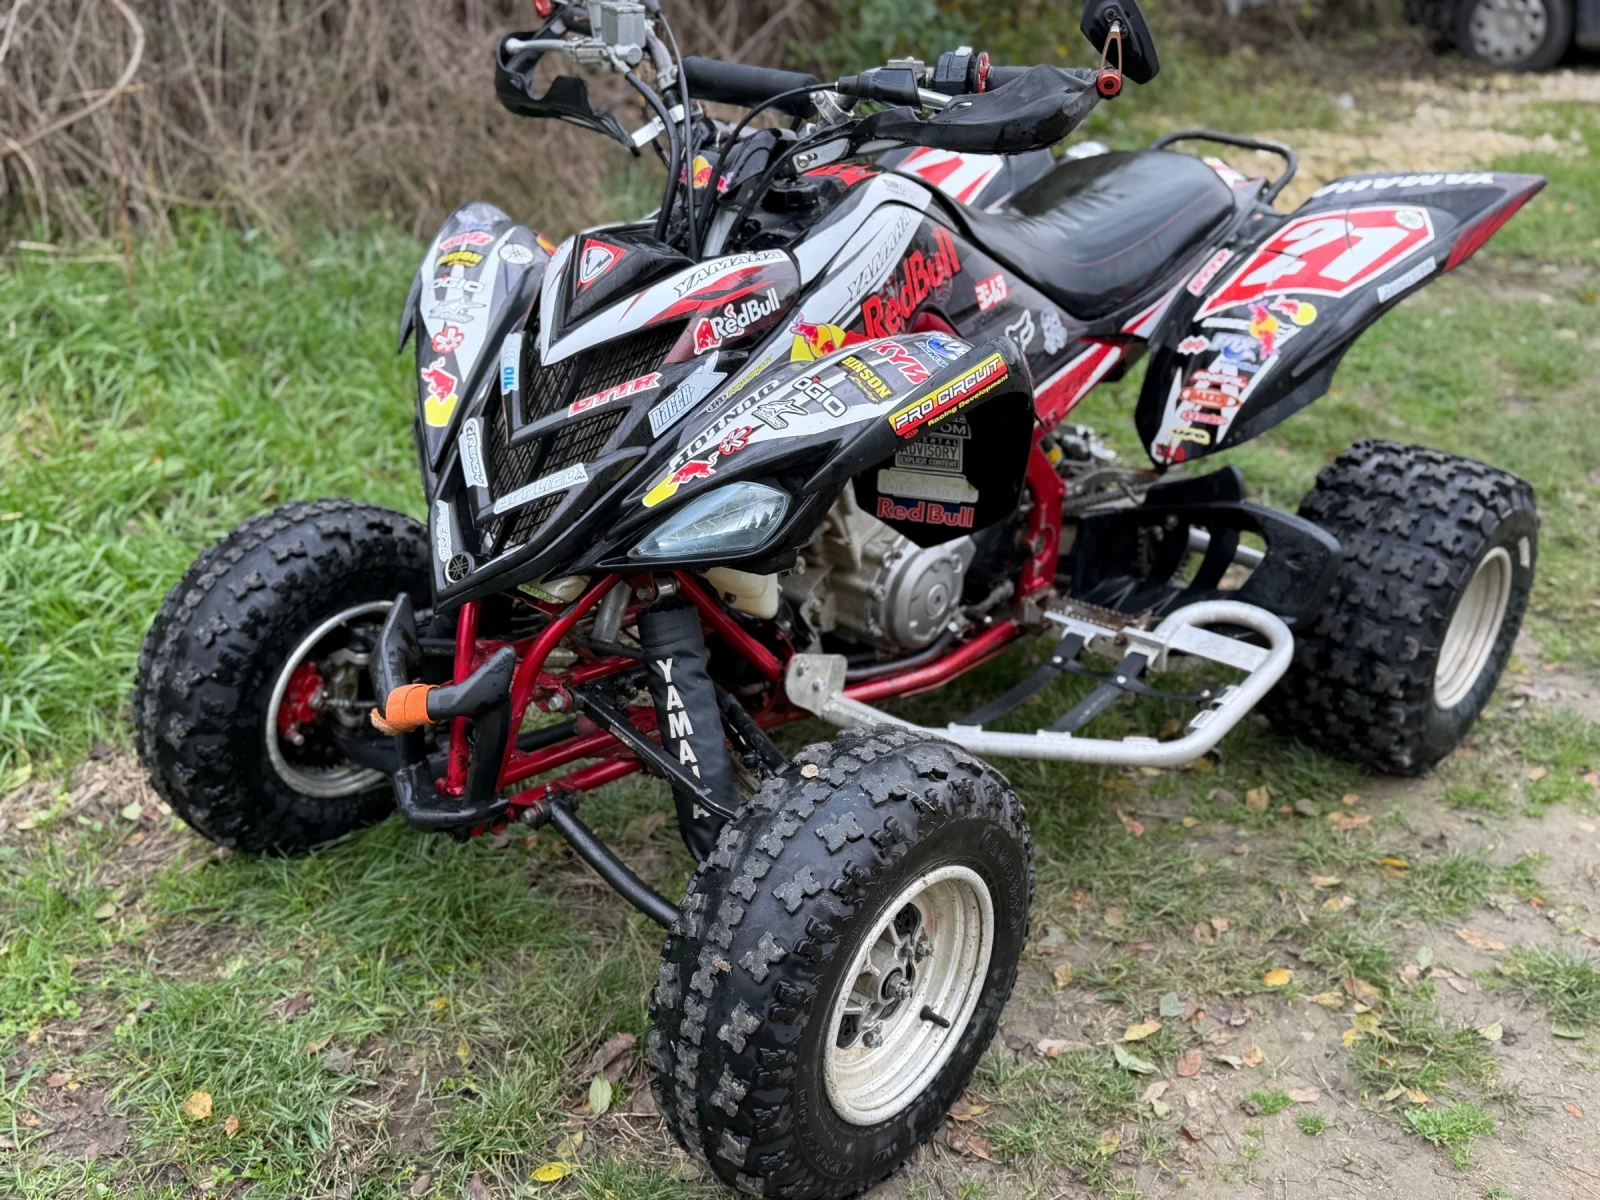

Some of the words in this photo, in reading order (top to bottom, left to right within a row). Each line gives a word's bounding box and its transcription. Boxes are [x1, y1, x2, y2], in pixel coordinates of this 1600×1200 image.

[674, 250, 784, 297] YAMAHA
[848, 208, 912, 301] YAMAHA
[913, 226, 961, 301] Bull
[711, 309, 747, 341] Red
[748, 287, 781, 323] Bull
[504, 366, 515, 390] OIL
[570, 372, 659, 411] GYTR
[792, 375, 848, 418] OGIO
[895, 398, 934, 431] PRO
[936, 357, 1001, 403] CIRCUIT
[927, 406, 958, 427] Racing
[958, 373, 1009, 409] Development
[900, 442, 958, 460] ADVISORY
[900, 455, 927, 465] EXPLICIT
[928, 458, 958, 468] CONTENT
[876, 496, 925, 523] Red
[926, 503, 975, 528] Bull
[656, 657, 711, 820] YAMAA
